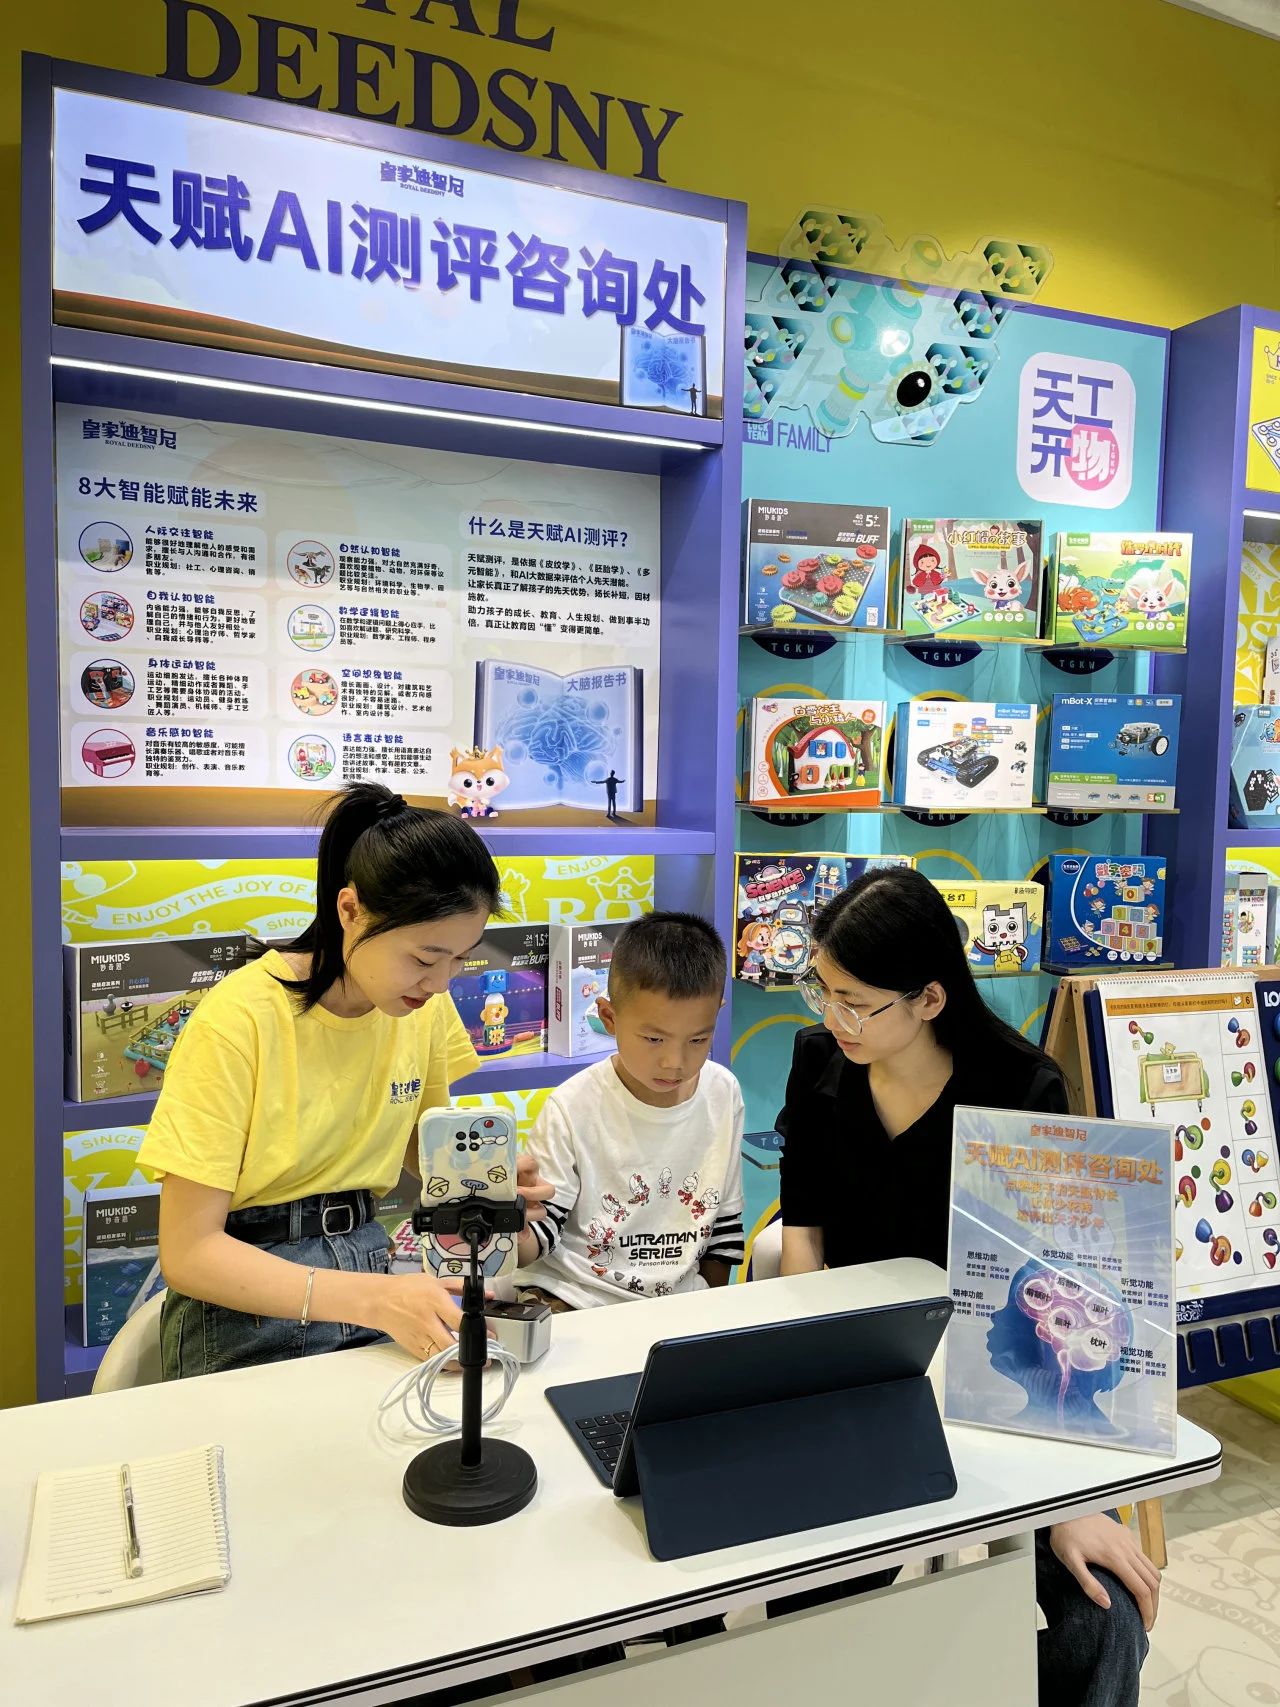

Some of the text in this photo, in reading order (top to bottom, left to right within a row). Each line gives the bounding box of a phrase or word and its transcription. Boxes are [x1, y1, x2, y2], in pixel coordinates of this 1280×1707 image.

[155, 0, 684, 183] DEEDSNY
[381, 161, 464, 198] 皇家迪智尼
[400, 183, 445, 197] ROYAL DEEDSNY
[77, 152, 706, 336] 天赋AI测评咨询处
[1033, 368, 1113, 429] 天工
[82, 419, 177, 450] 皇家迪智尼
[777, 422, 831, 453] FAMILY
[127, 441, 156, 450] DEEDSNY
[1030, 424, 1111, 482] 开物
[78, 476, 258, 513] 8大智能赋能未来
[758, 506, 789, 515] MIUKIDS
[145, 525, 214, 540] 人际交往智能
[468, 515, 628, 548] 什么是天赋AI测评?
[947, 529, 1028, 547] 小红帽の故事
[855, 534, 880, 544] BUFF
[339, 543, 401, 557] 自然认知智能
[147, 590, 215, 604] 自我认知智能
[339, 607, 400, 619] 数学逻辑智能
[771, 642, 814, 653] TGKW
[922, 651, 962, 662] TGKW
[148, 658, 216, 671] 身体运动智能
[1059, 659, 1095, 669] TGKW
[341, 669, 403, 680] 空间想象智能
[567, 671, 627, 693] 大脑报告书
[1061, 697, 1093, 706] mBot-X
[794, 703, 841, 716] 白雪公主
[146, 727, 214, 739] 音乐感知智能
[342, 733, 404, 744] 语言表达智能
[917, 812, 956, 821] TGKW
[1053, 812, 1089, 821] TGKW
[745, 869, 804, 899] SCIENCE
[616, 883, 633, 899] R
[112, 880, 308, 926] ENJOY THE JOY OF
[266, 918, 308, 930] SINC
[578, 932, 603, 941] MIUKIDS
[91, 953, 130, 965] MIUKIDS
[528, 954, 549, 965] BUFF
[1245, 996, 1250, 1005] 6
[1264, 990, 1280, 1008] LO
[81, 1134, 140, 1149] SINCE
[963, 1141, 1163, 1185] 天赋AI测评咨询处
[96, 1206, 137, 1218] MIUKIDS
[618, 1230, 698, 1248] ULTRAMAN
[628, 1246, 683, 1260] SERIES
[967, 1250, 998, 1262] 思维功能
[1042, 1248, 1074, 1261] 体觉功能
[1121, 1277, 1154, 1289] 听觉功能
[952, 1288, 984, 1300] 精神功能
[1090, 1336, 1107, 1349] 枕叶
[1120, 1346, 1154, 1359] 视觉功能
